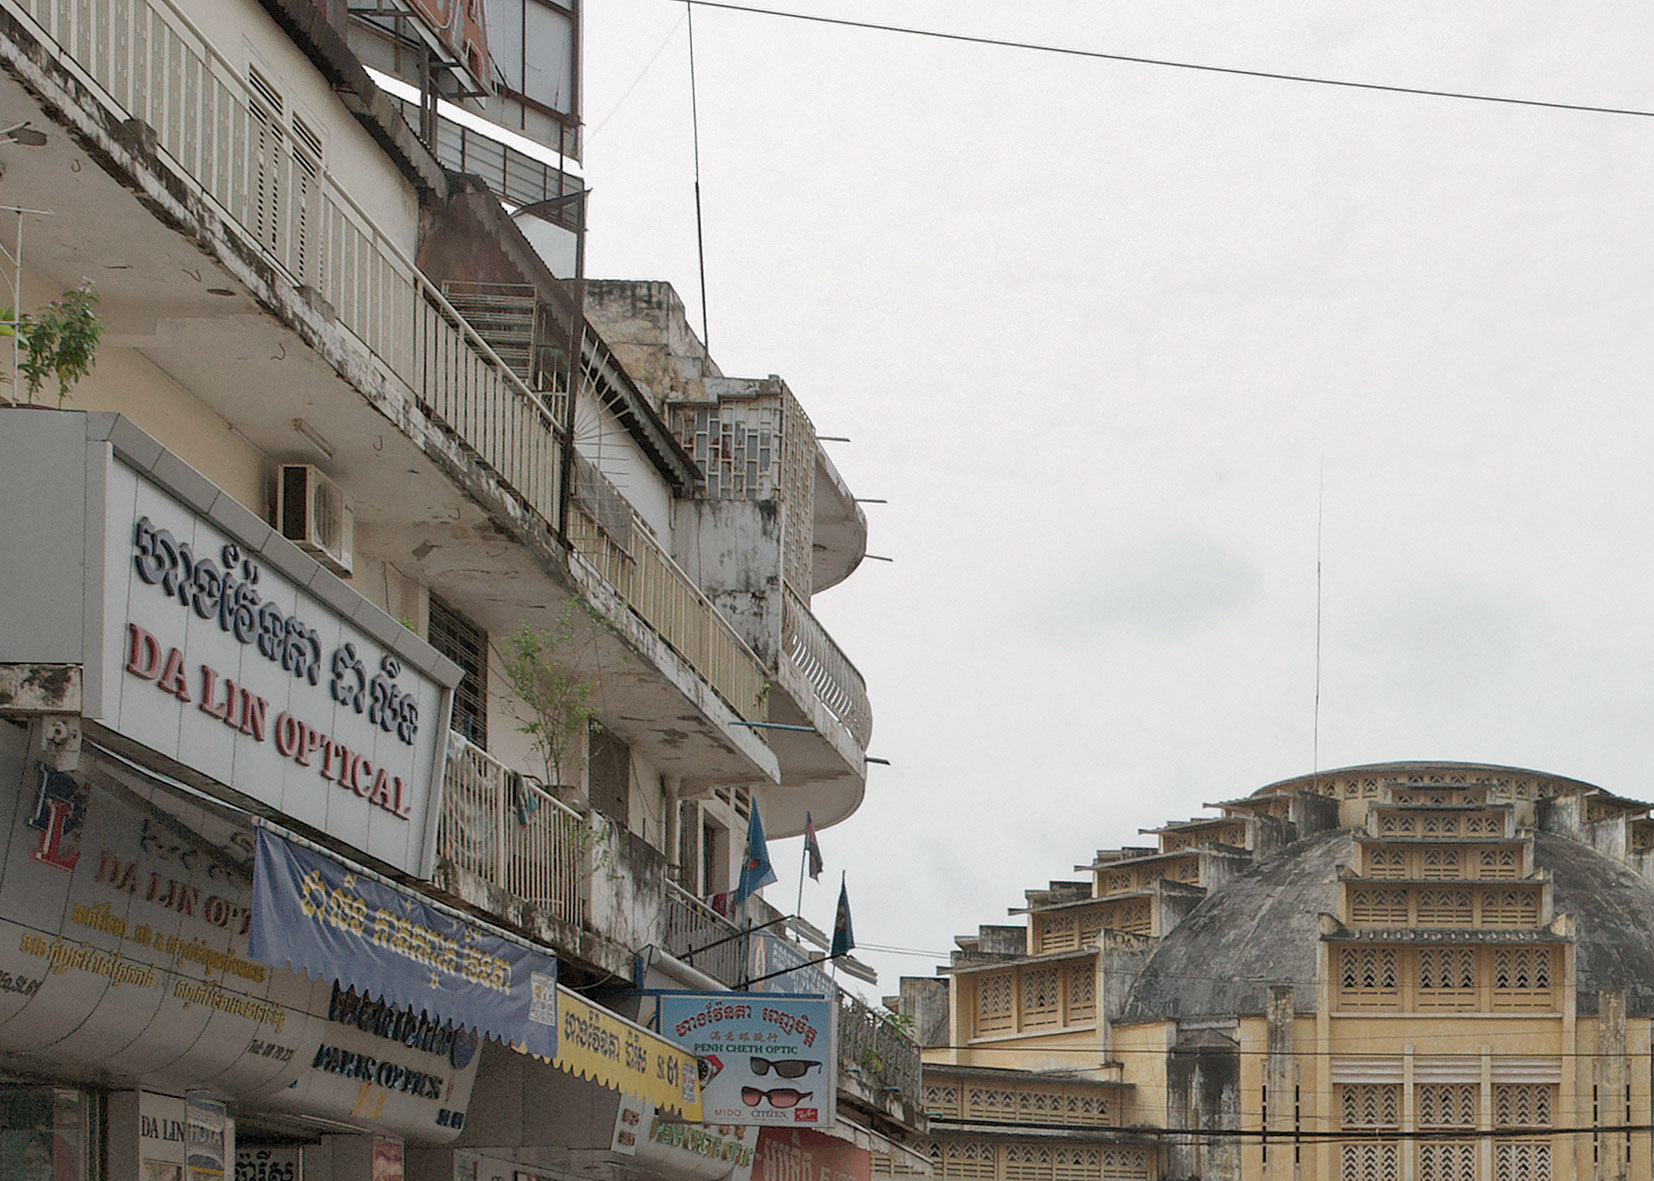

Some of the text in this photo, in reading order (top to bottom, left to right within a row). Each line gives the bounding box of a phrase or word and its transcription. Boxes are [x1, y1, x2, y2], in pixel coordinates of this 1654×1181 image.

[126, 622, 412, 821] DA LIN OPTICAL
[694, 1043, 798, 1055] PENH CHETH OPTIC
[714, 1108, 741, 1117] MIDO
[751, 1109, 788, 1119] CITIZEN
